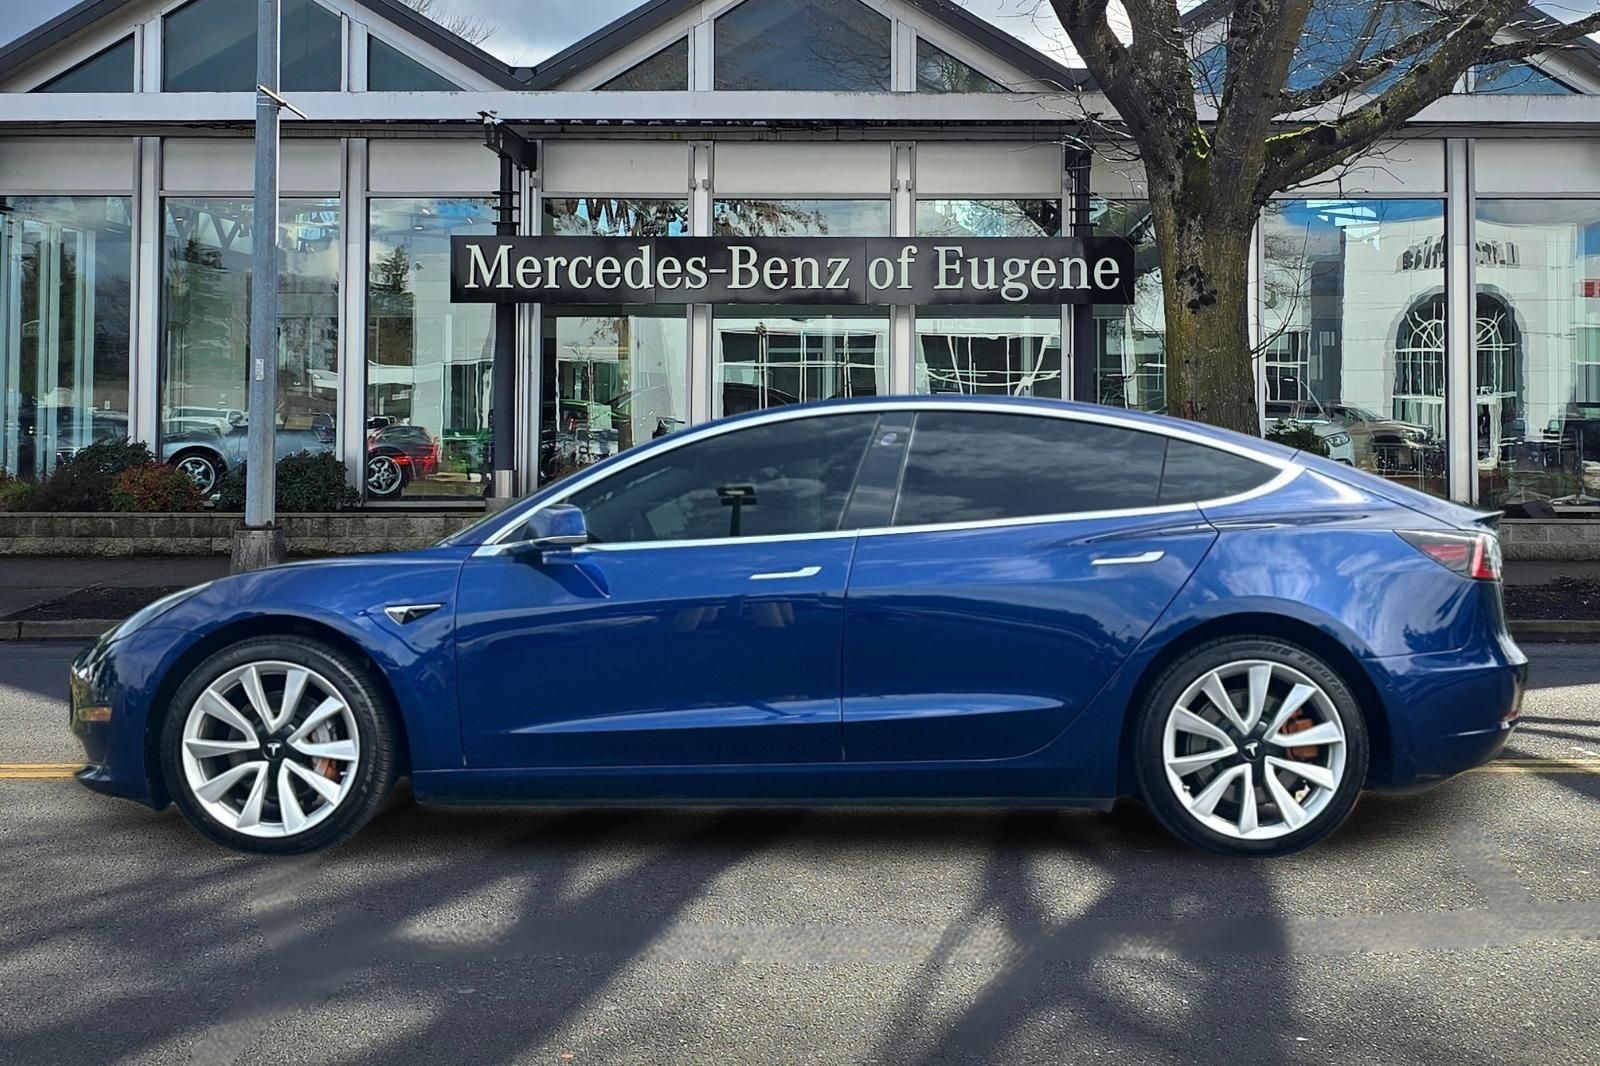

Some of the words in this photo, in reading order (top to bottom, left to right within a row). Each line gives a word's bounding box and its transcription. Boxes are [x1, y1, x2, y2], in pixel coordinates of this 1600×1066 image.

[464, 244, 851, 290] Mercedes-Benz
[868, 245, 918, 290] of
[933, 246, 1120, 302] Eugene
